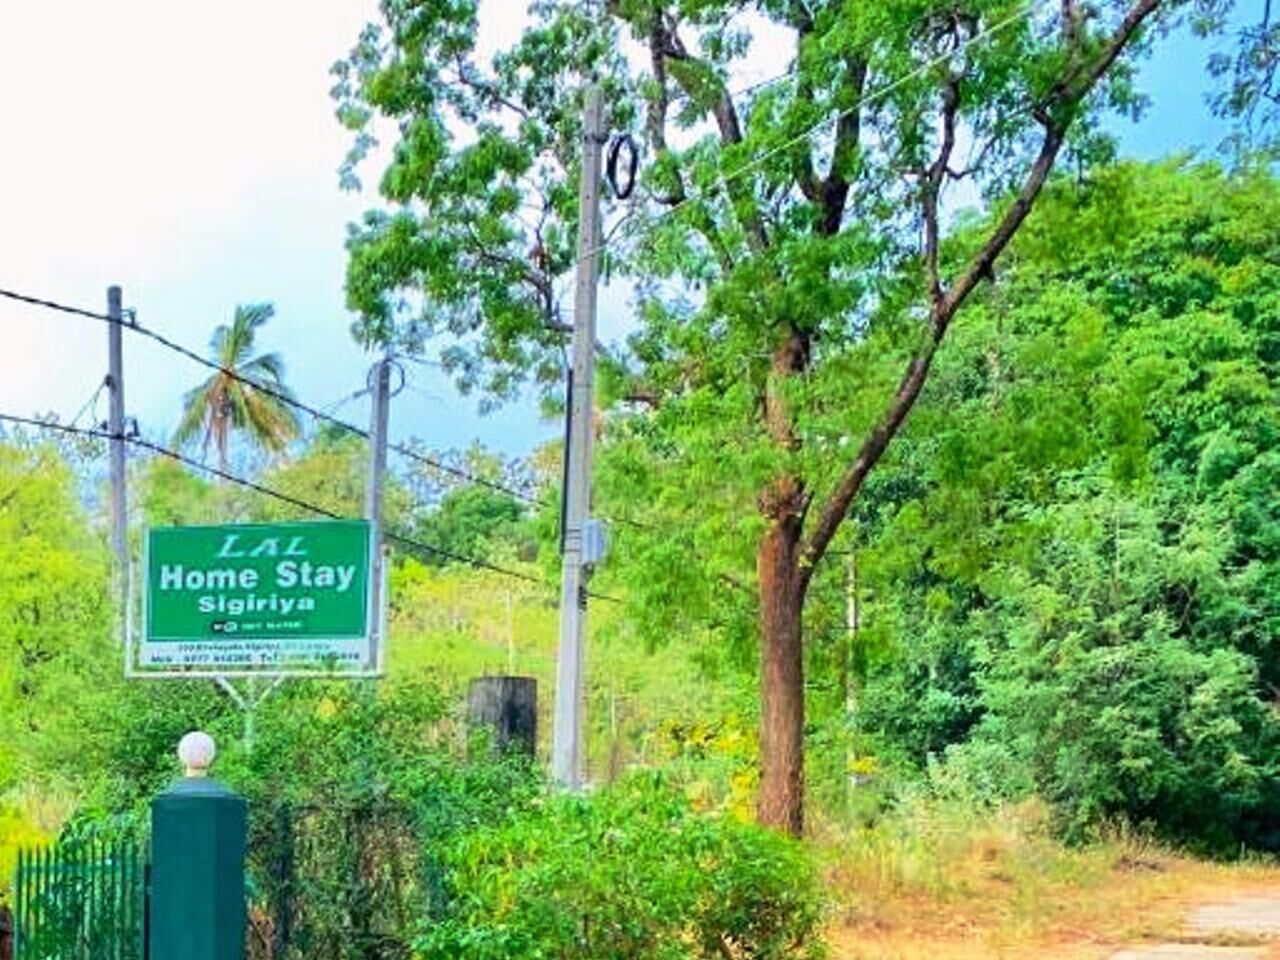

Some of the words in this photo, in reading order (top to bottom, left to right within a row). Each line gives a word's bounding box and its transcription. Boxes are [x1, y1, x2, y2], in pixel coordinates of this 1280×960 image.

[217, 534, 309, 558] LAL
[160, 564, 259, 590] Home
[276, 561, 356, 591] Stay
[198, 593, 316, 615] Sigiriya
